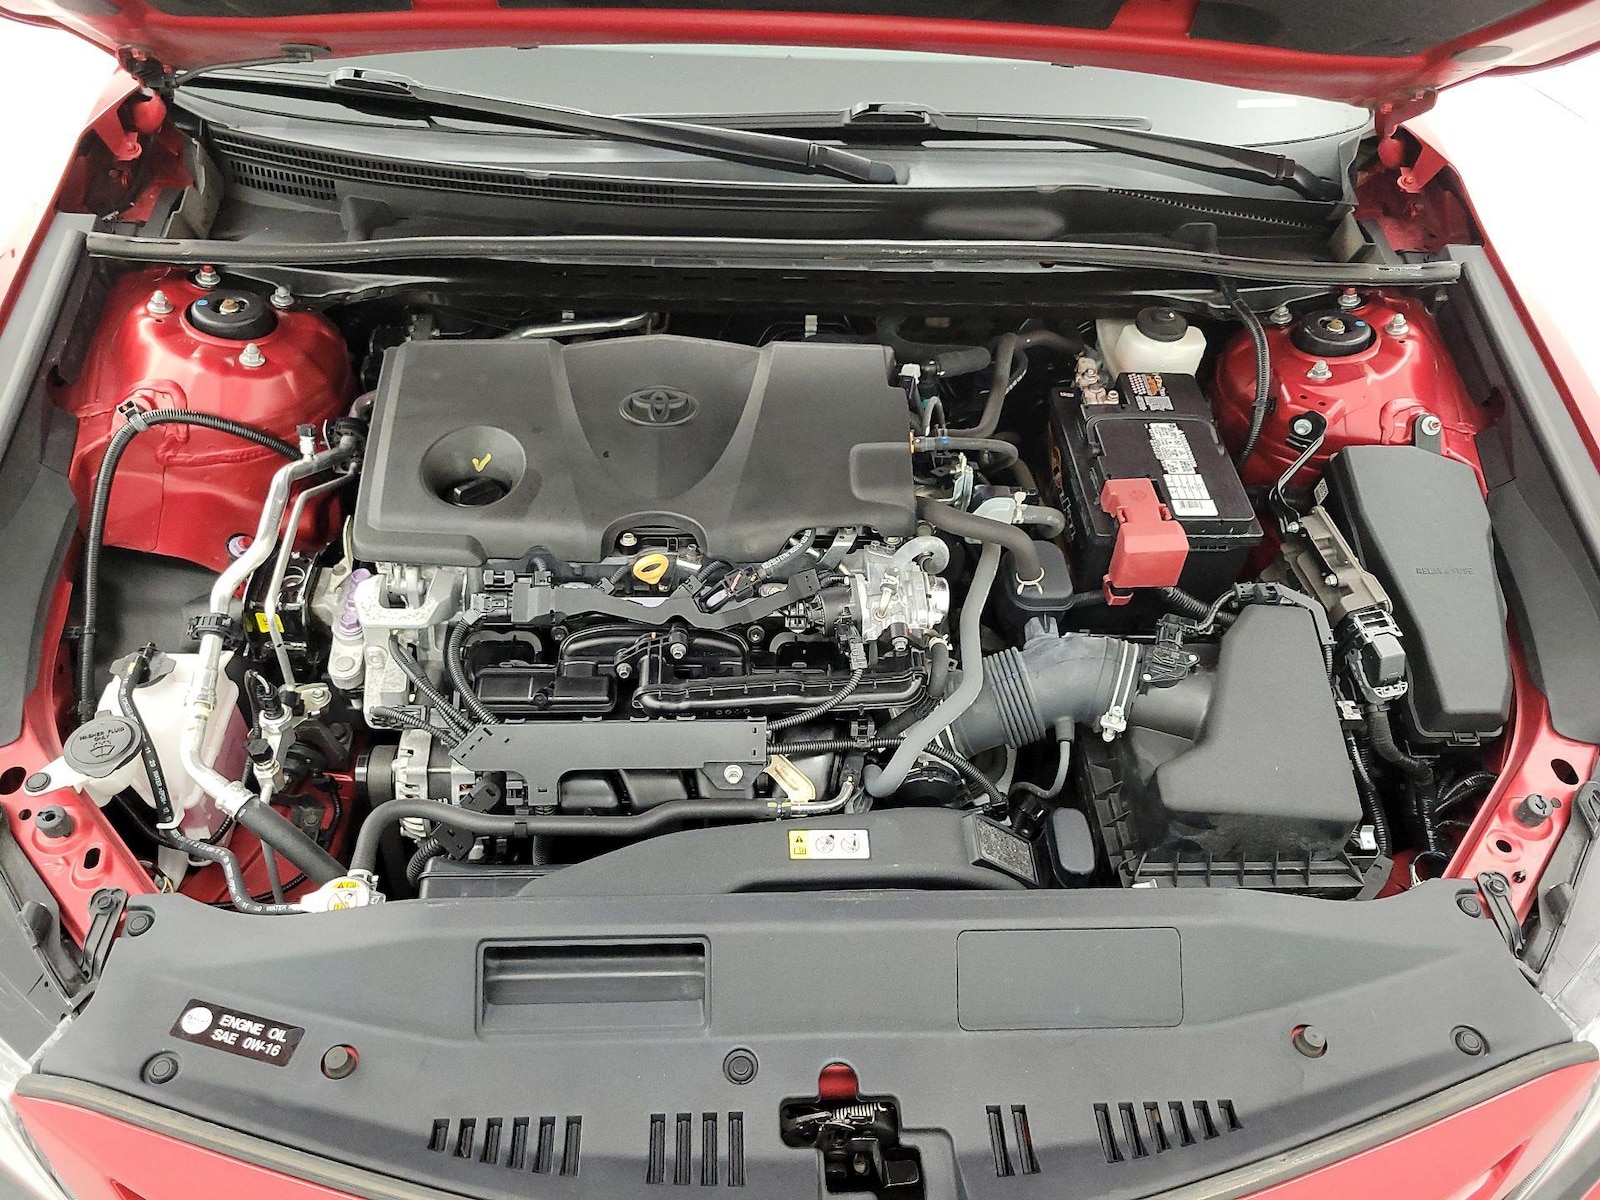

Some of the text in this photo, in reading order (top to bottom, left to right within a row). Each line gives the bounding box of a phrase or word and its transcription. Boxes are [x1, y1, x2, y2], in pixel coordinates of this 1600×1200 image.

[211, 1028, 282, 1057] SAE 0W-16
[218, 1014, 287, 1043] ENGINE OIL
